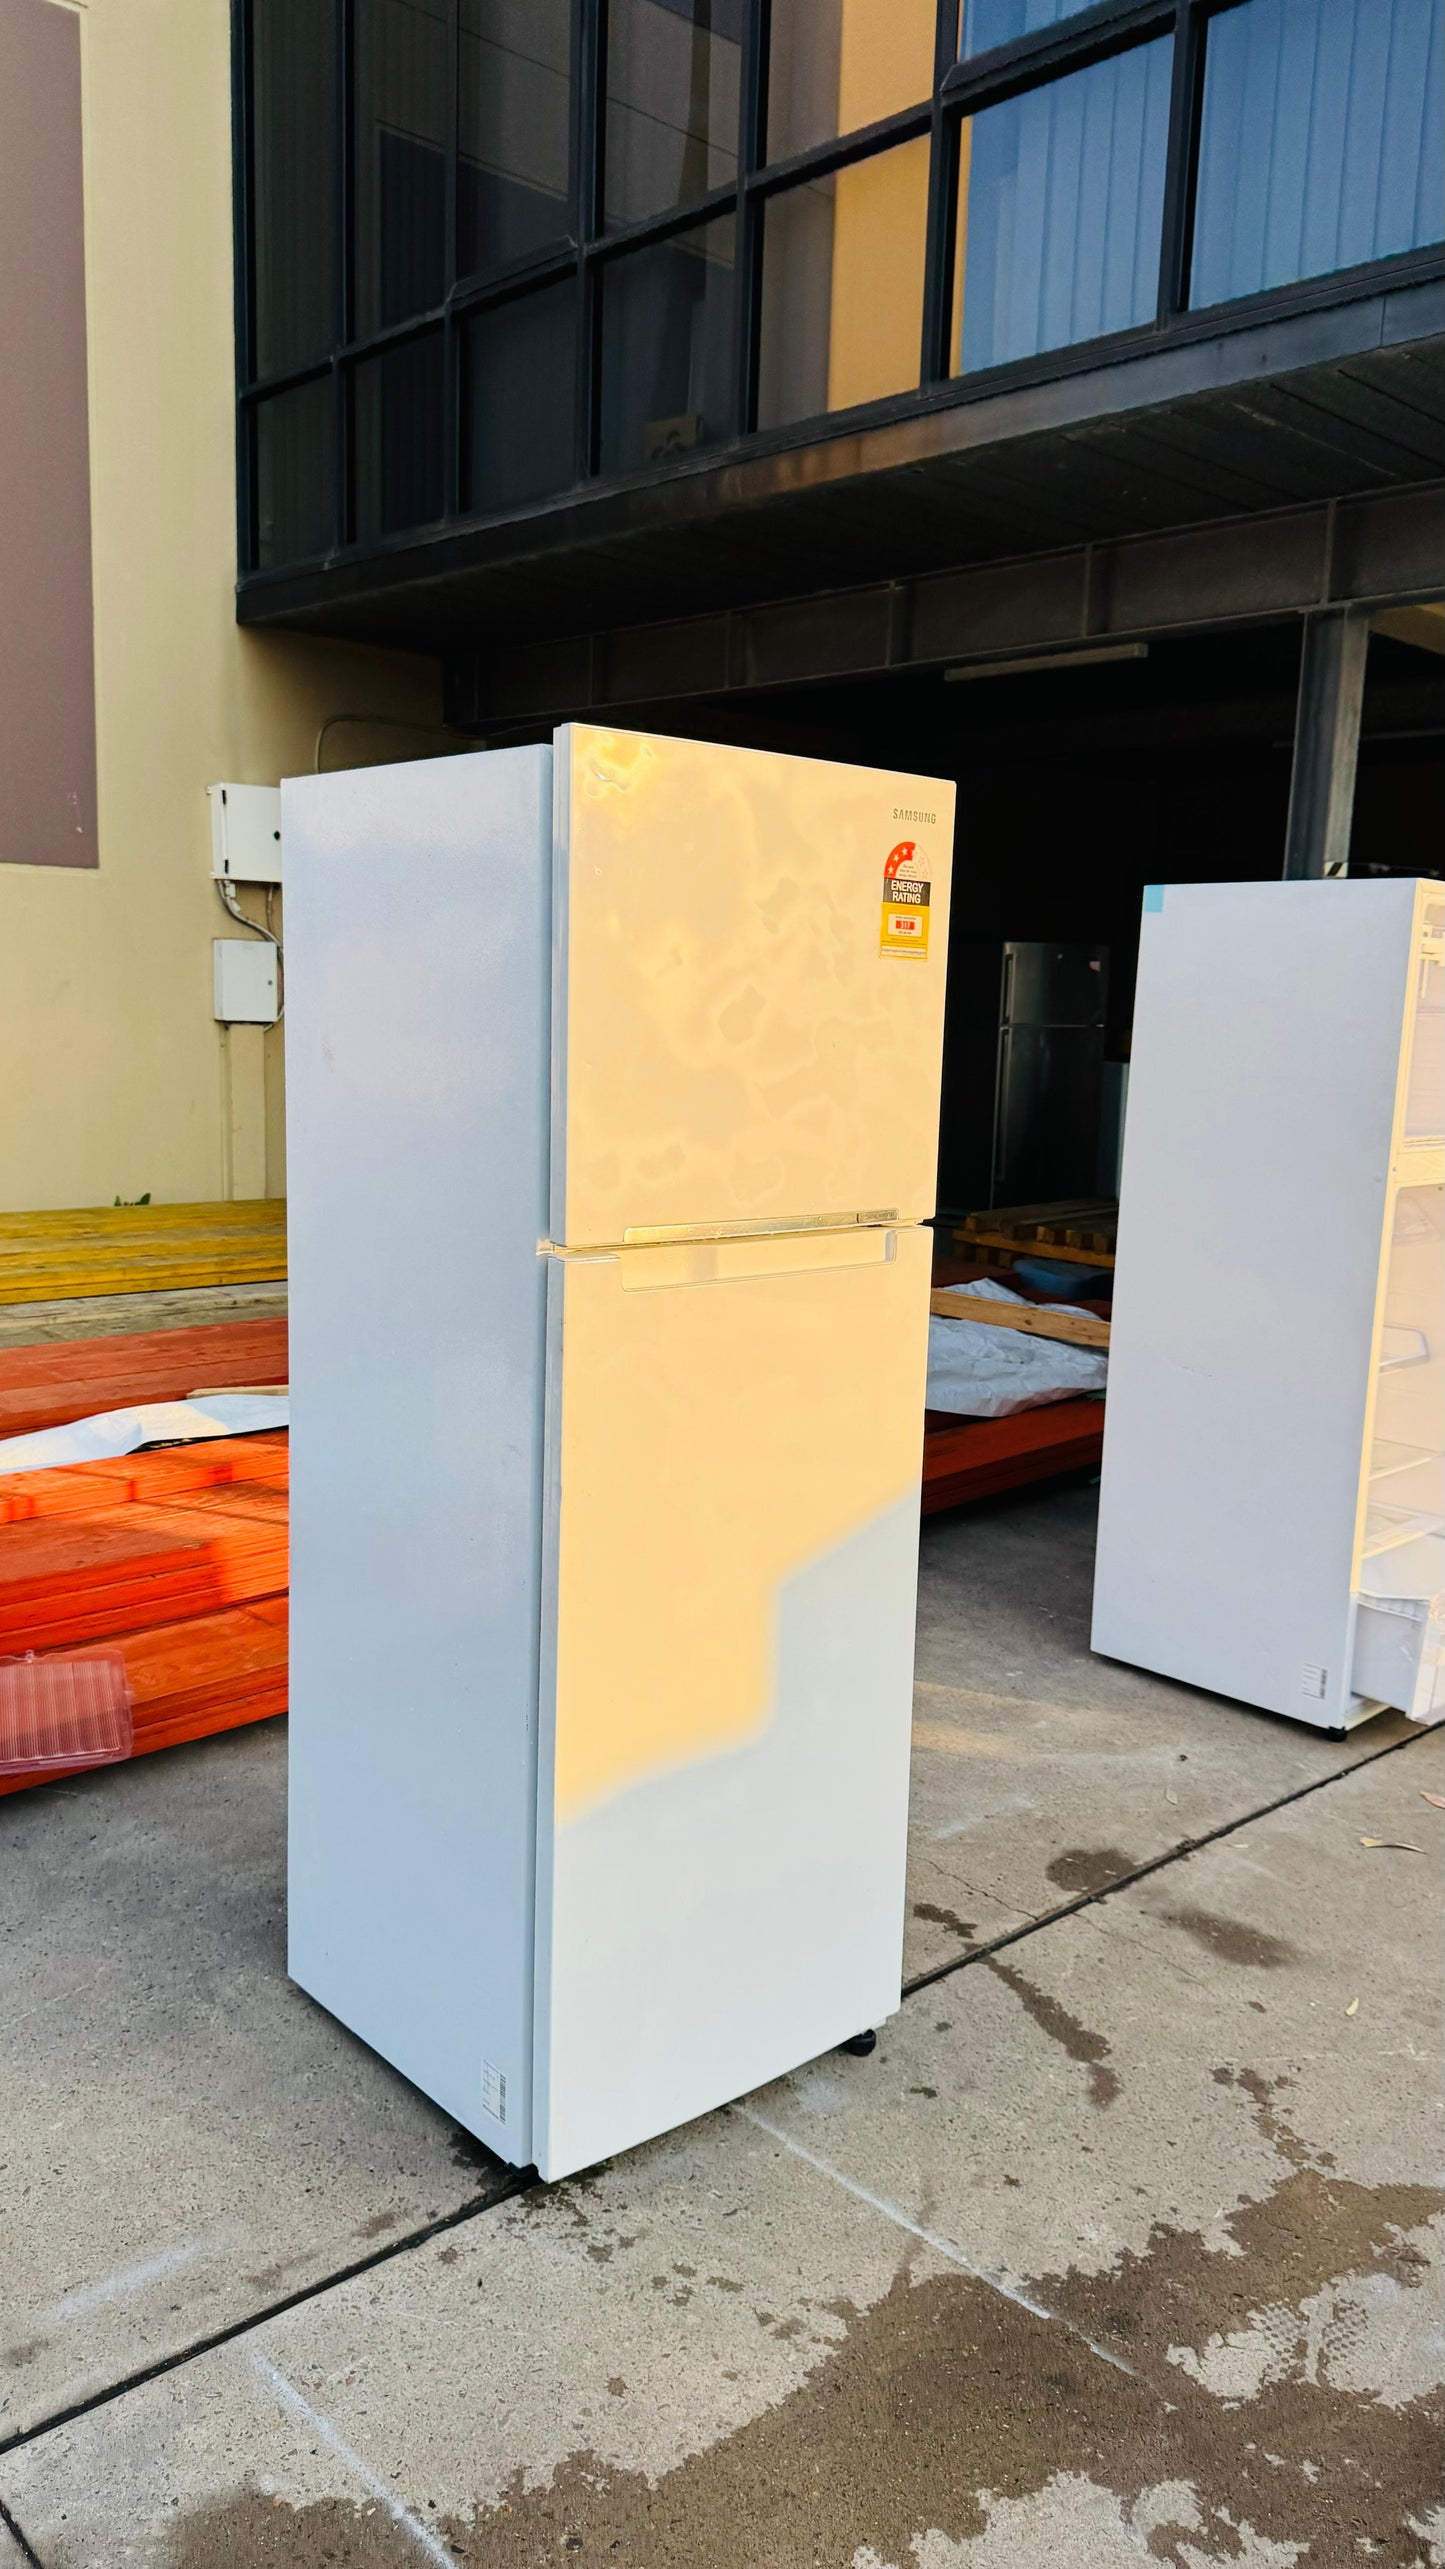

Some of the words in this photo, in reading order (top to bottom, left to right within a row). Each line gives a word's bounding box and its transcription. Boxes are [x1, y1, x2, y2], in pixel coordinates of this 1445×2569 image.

[893, 808, 937, 824] SAMSUNG
[891, 880, 924, 893] ENERGY
[892, 891, 921, 904] RATING
